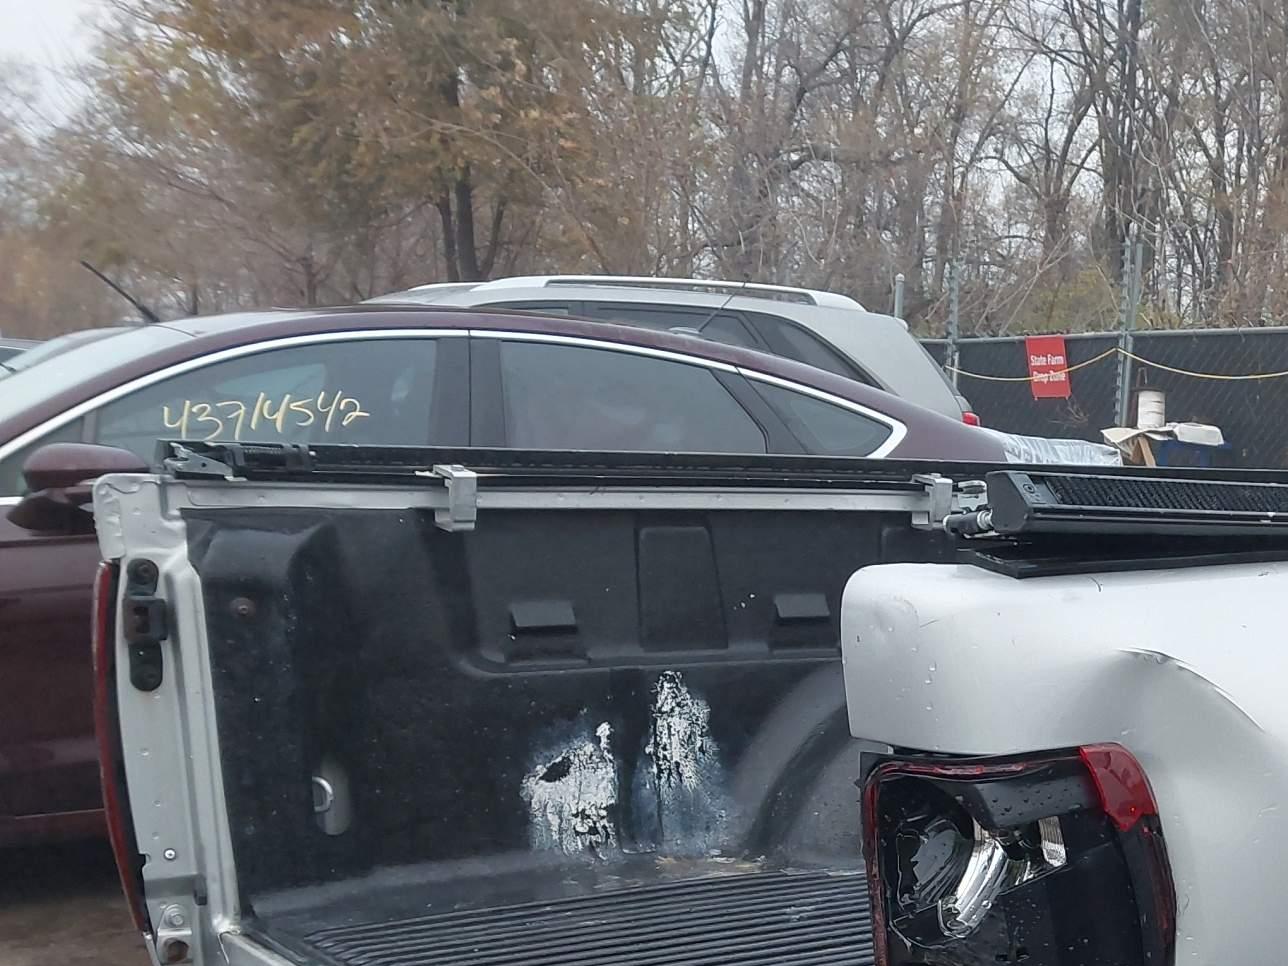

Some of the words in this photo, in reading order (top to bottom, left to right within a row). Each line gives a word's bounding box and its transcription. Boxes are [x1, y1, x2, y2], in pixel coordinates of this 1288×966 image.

[1030, 354, 1047, 366] State
[1047, 353, 1064, 365] Farm
[163, 390, 370, 440] 43714542
